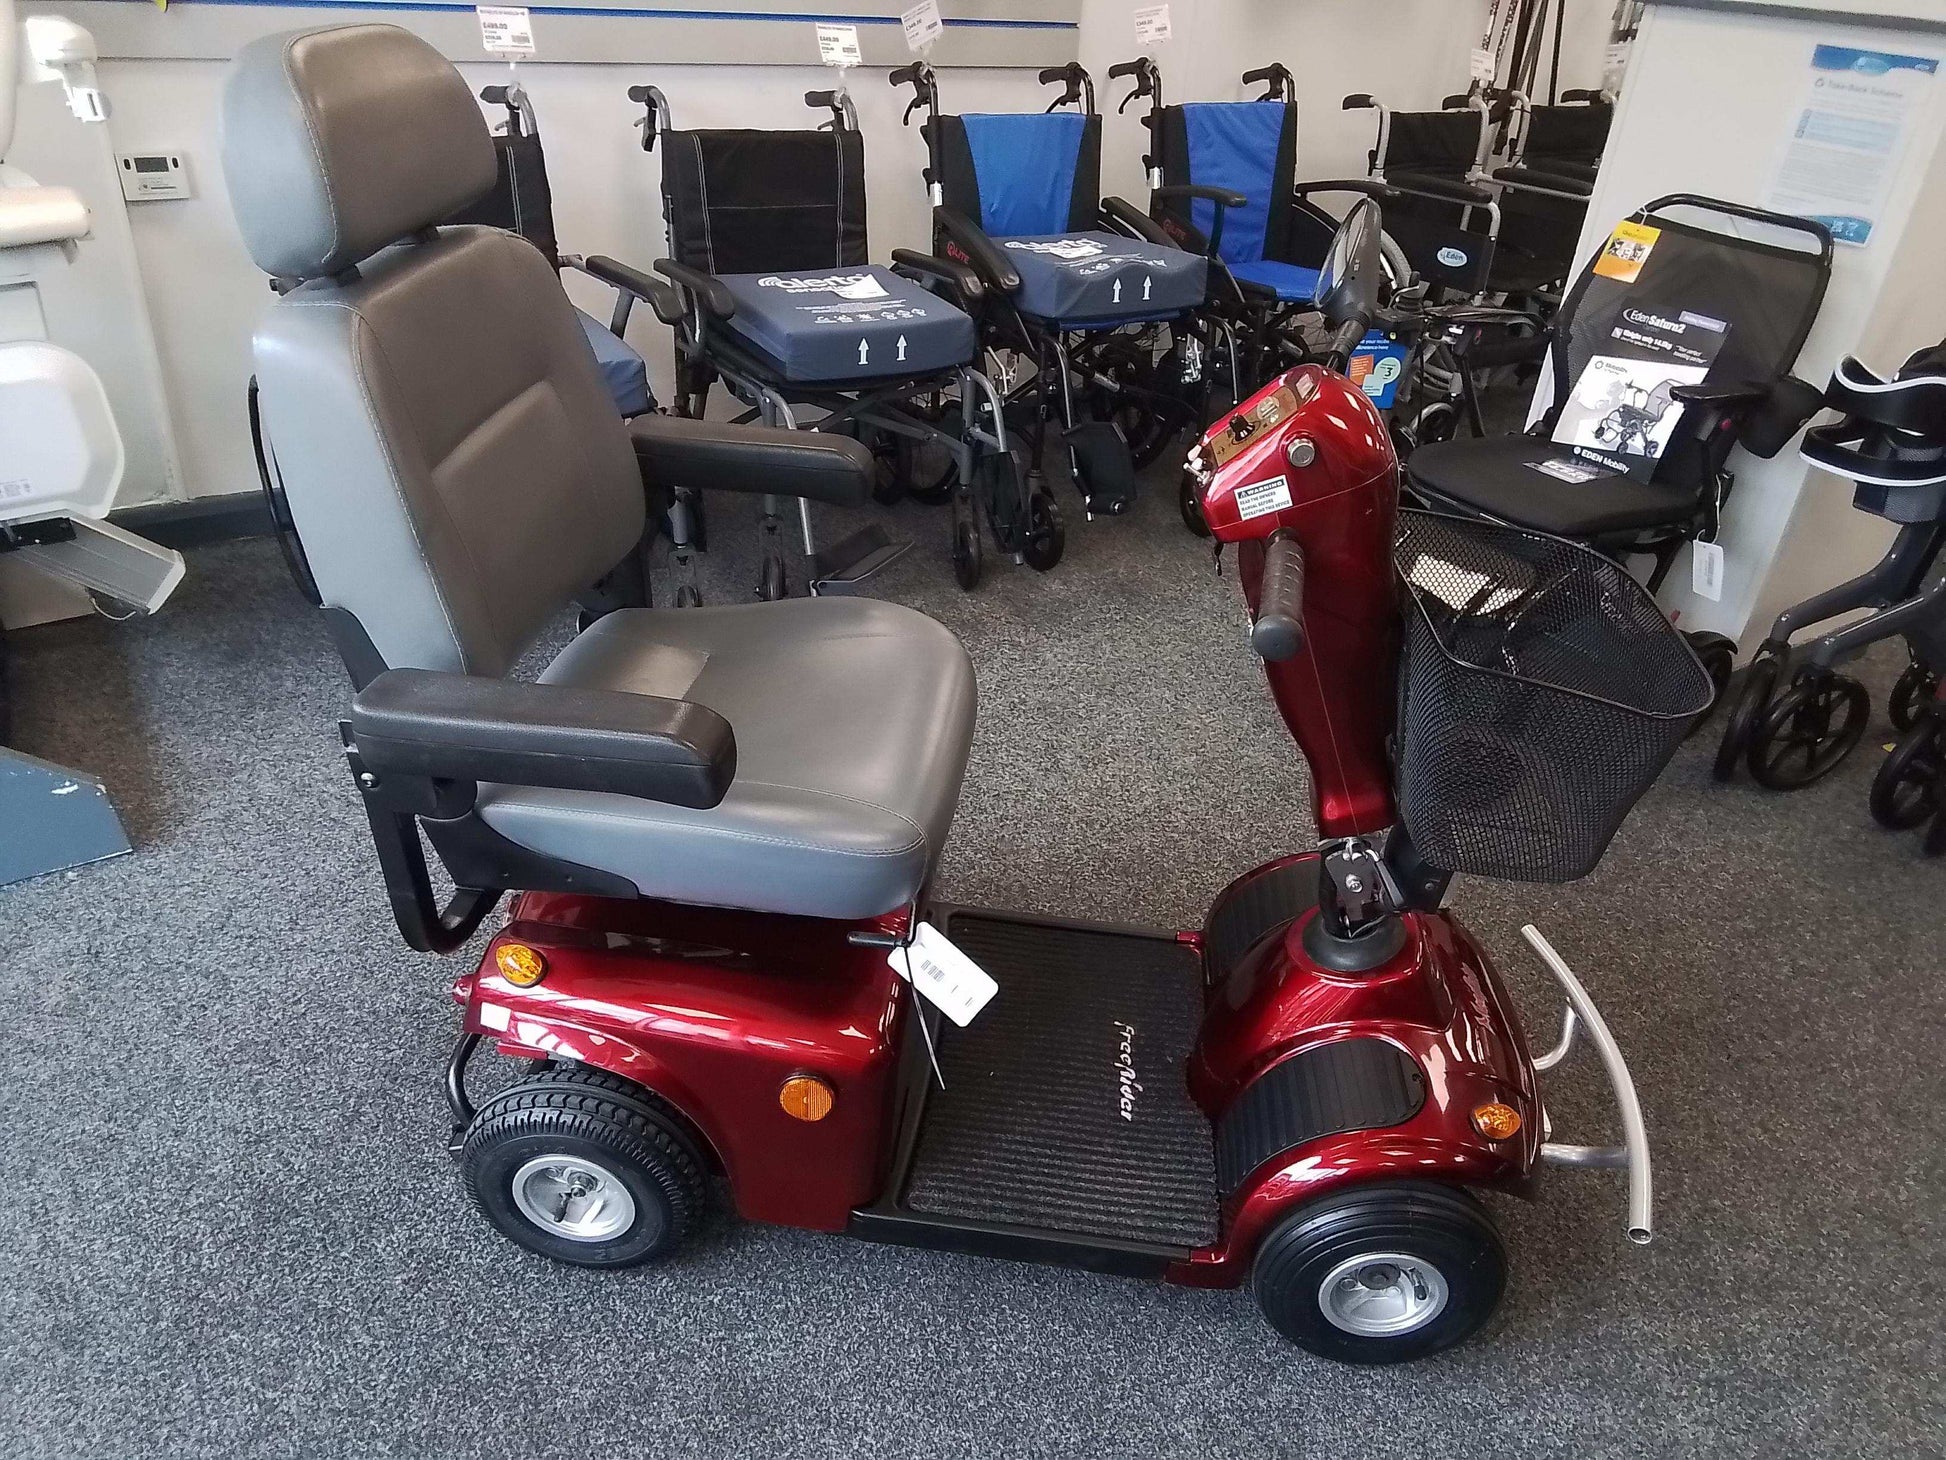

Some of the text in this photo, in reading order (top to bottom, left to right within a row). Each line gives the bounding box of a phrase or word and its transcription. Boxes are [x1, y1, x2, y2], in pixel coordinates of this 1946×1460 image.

[1384, 367, 1394, 377] 3
[1581, 449, 1604, 463] EDEN
[1602, 456, 1631, 474] Mobility
[1246, 480, 1283, 496] WARNING
[1113, 1021, 1143, 1122] FreeRider
